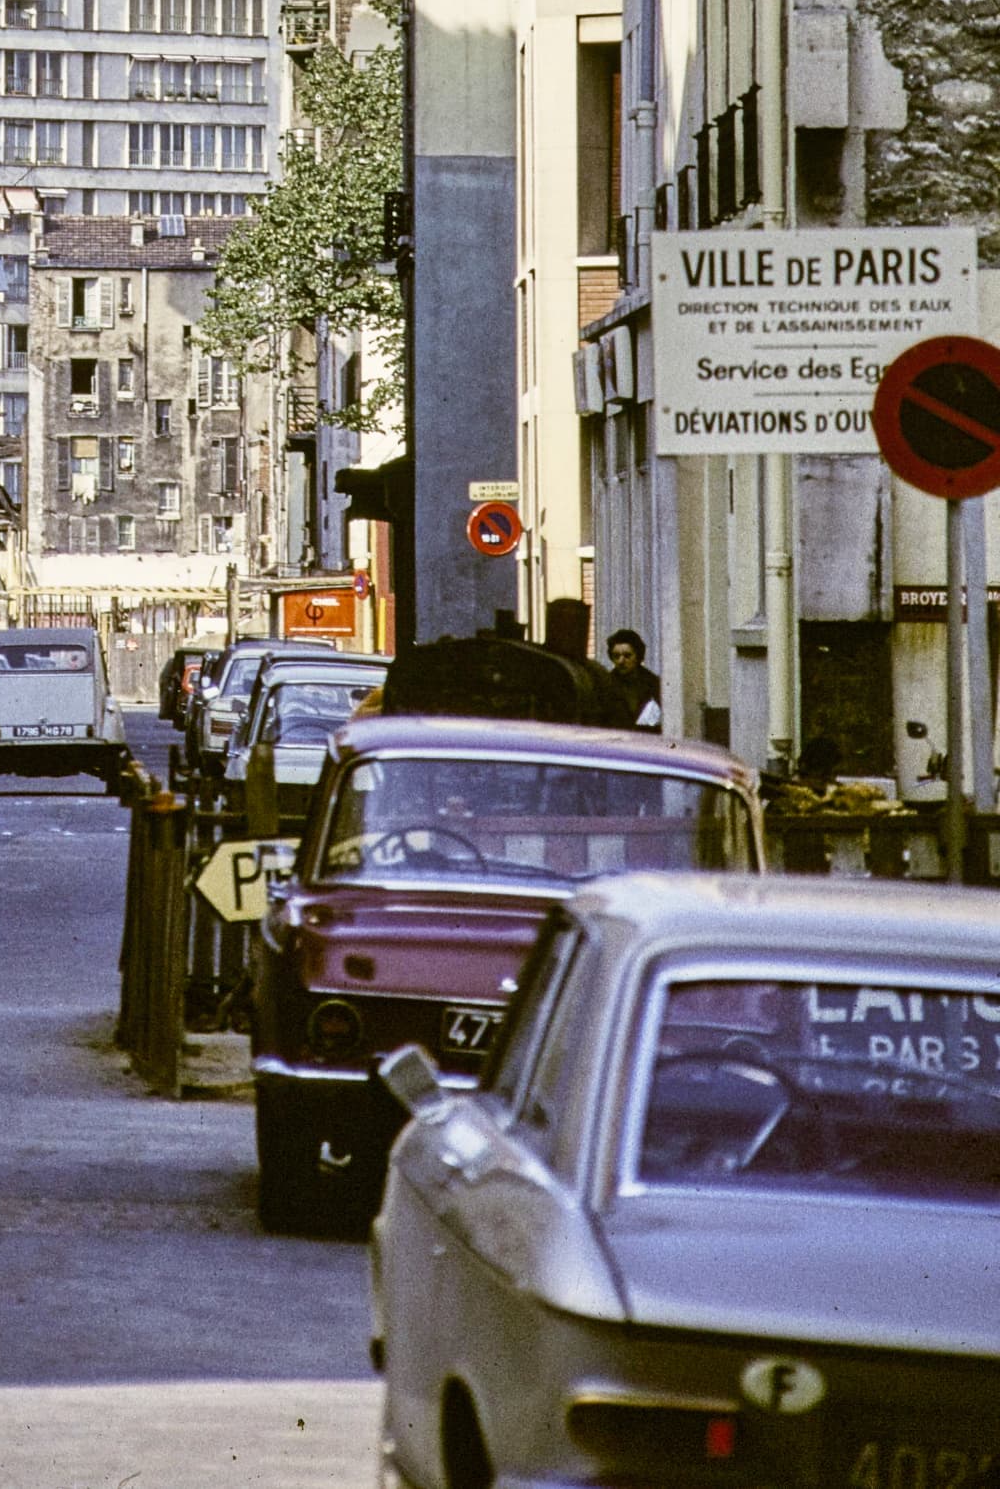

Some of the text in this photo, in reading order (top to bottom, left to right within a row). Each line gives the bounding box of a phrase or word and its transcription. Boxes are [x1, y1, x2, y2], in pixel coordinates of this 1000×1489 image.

[681, 247, 941, 288] VILLE DE PARIS
[678, 299, 952, 315] DIRECTION TECHNIQUE DES EAUX
[708, 319, 924, 334] ET DE L'ASSAINISSEMENT
[697, 357, 789, 381] Service
[798, 356, 843, 380] des
[674, 407, 807, 434] DÉVIATIONS
